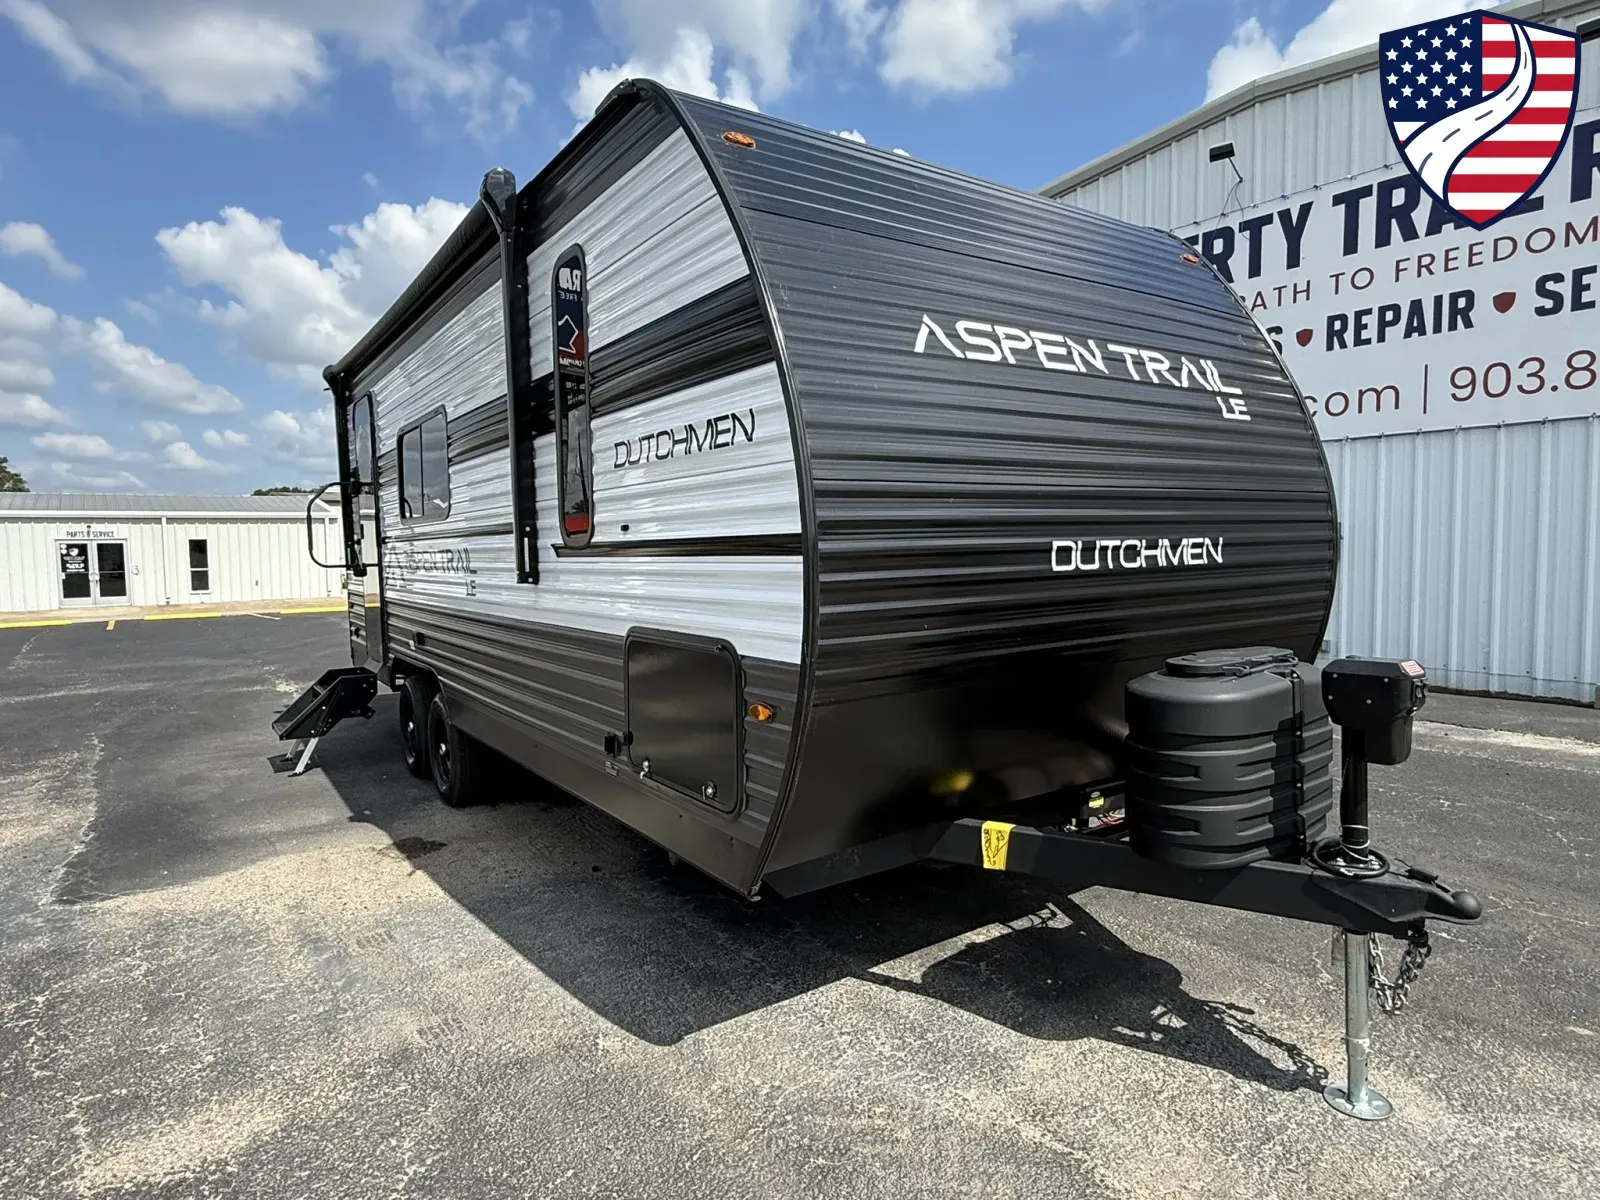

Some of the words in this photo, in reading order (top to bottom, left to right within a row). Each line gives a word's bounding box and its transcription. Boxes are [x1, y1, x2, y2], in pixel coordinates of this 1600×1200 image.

[1182, 200, 1315, 284] RTY
[1239, 279, 1311, 312] ATH
[1329, 267, 1376, 296] TO
[1394, 215, 1599, 283] FREEDOM
[1325, 289, 1476, 352] REPAIR
[1533, 264, 1598, 318] SE
[914, 313, 1109, 375] ASPEN
[1106, 343, 1243, 395] TRAIL
[1449, 349, 1597, 403] 903.8
[613, 408, 756, 469] DUTCHMEN
[1216, 395, 1252, 421] LE
[66, 530, 86, 538] PARTS
[91, 530, 115, 538] SERVICE
[1051, 537, 1223, 572] DUTCHMEN
